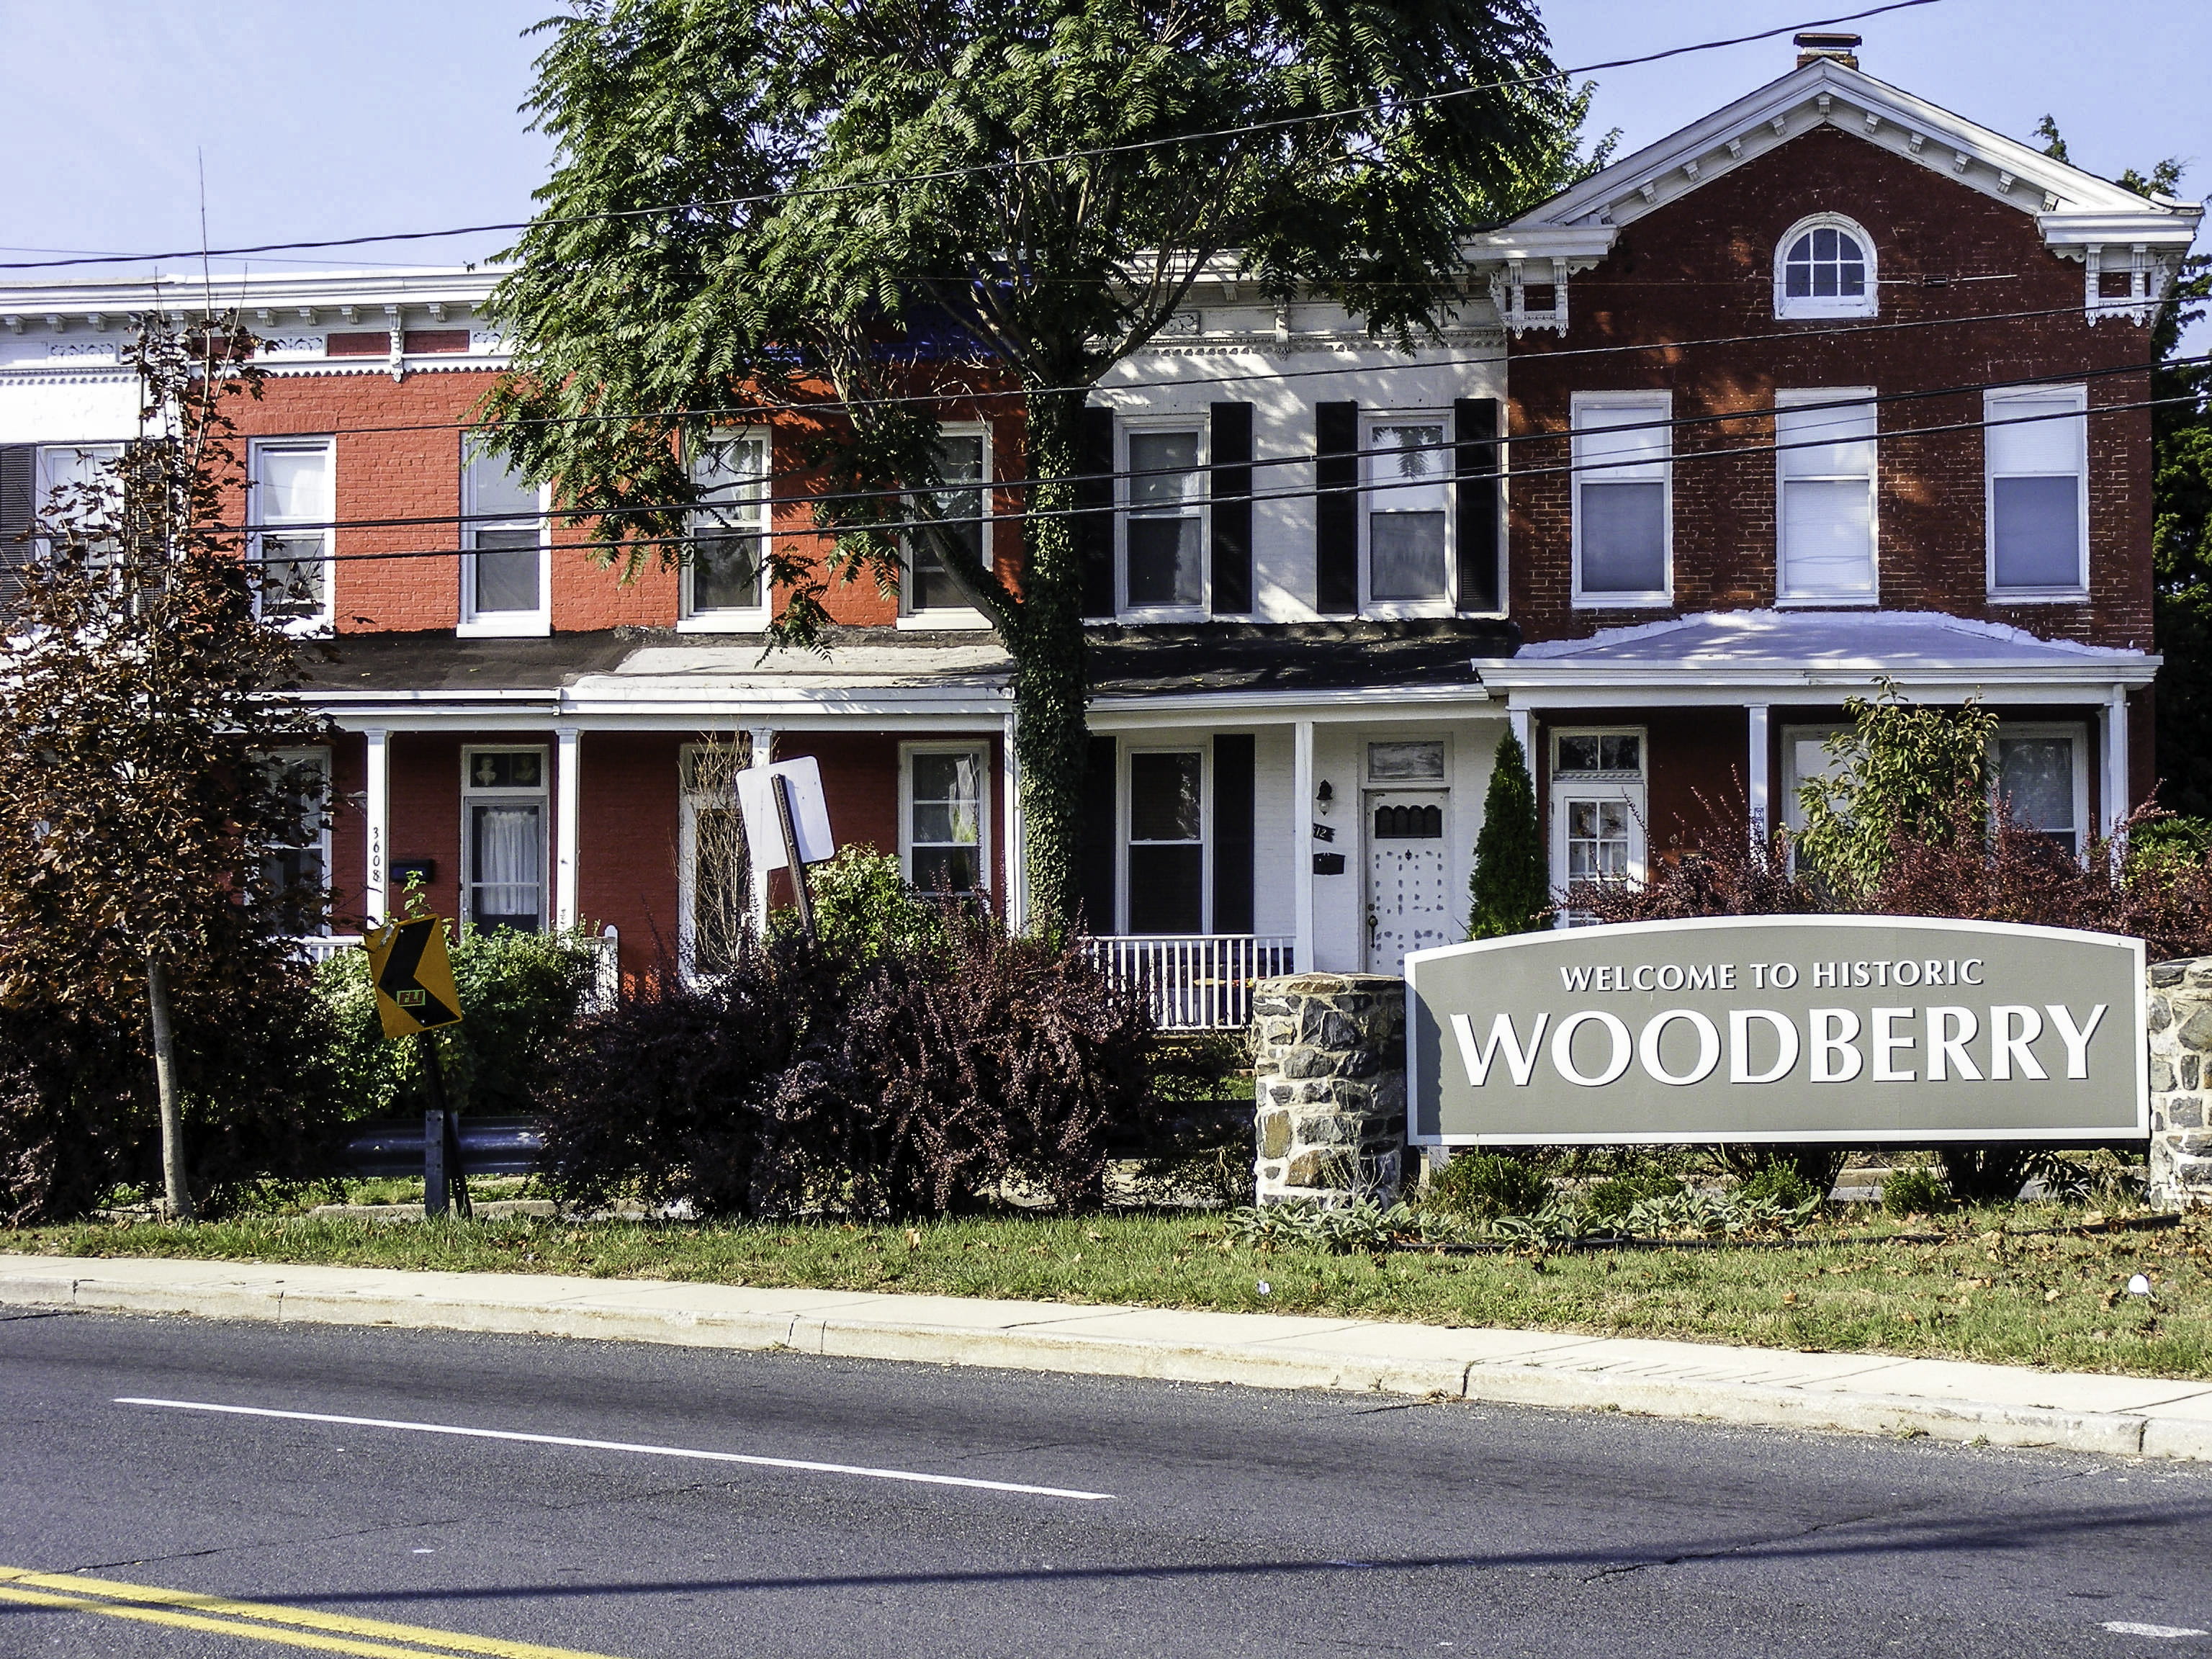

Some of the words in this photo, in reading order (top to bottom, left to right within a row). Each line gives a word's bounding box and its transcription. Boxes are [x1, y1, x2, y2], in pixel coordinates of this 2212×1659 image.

[1559, 963, 1737, 992] WELCOME
[1749, 963, 1799, 989] TO
[1812, 958, 1984, 987] HISTORIC
[1449, 1004, 2108, 1087] WOODBERRY
